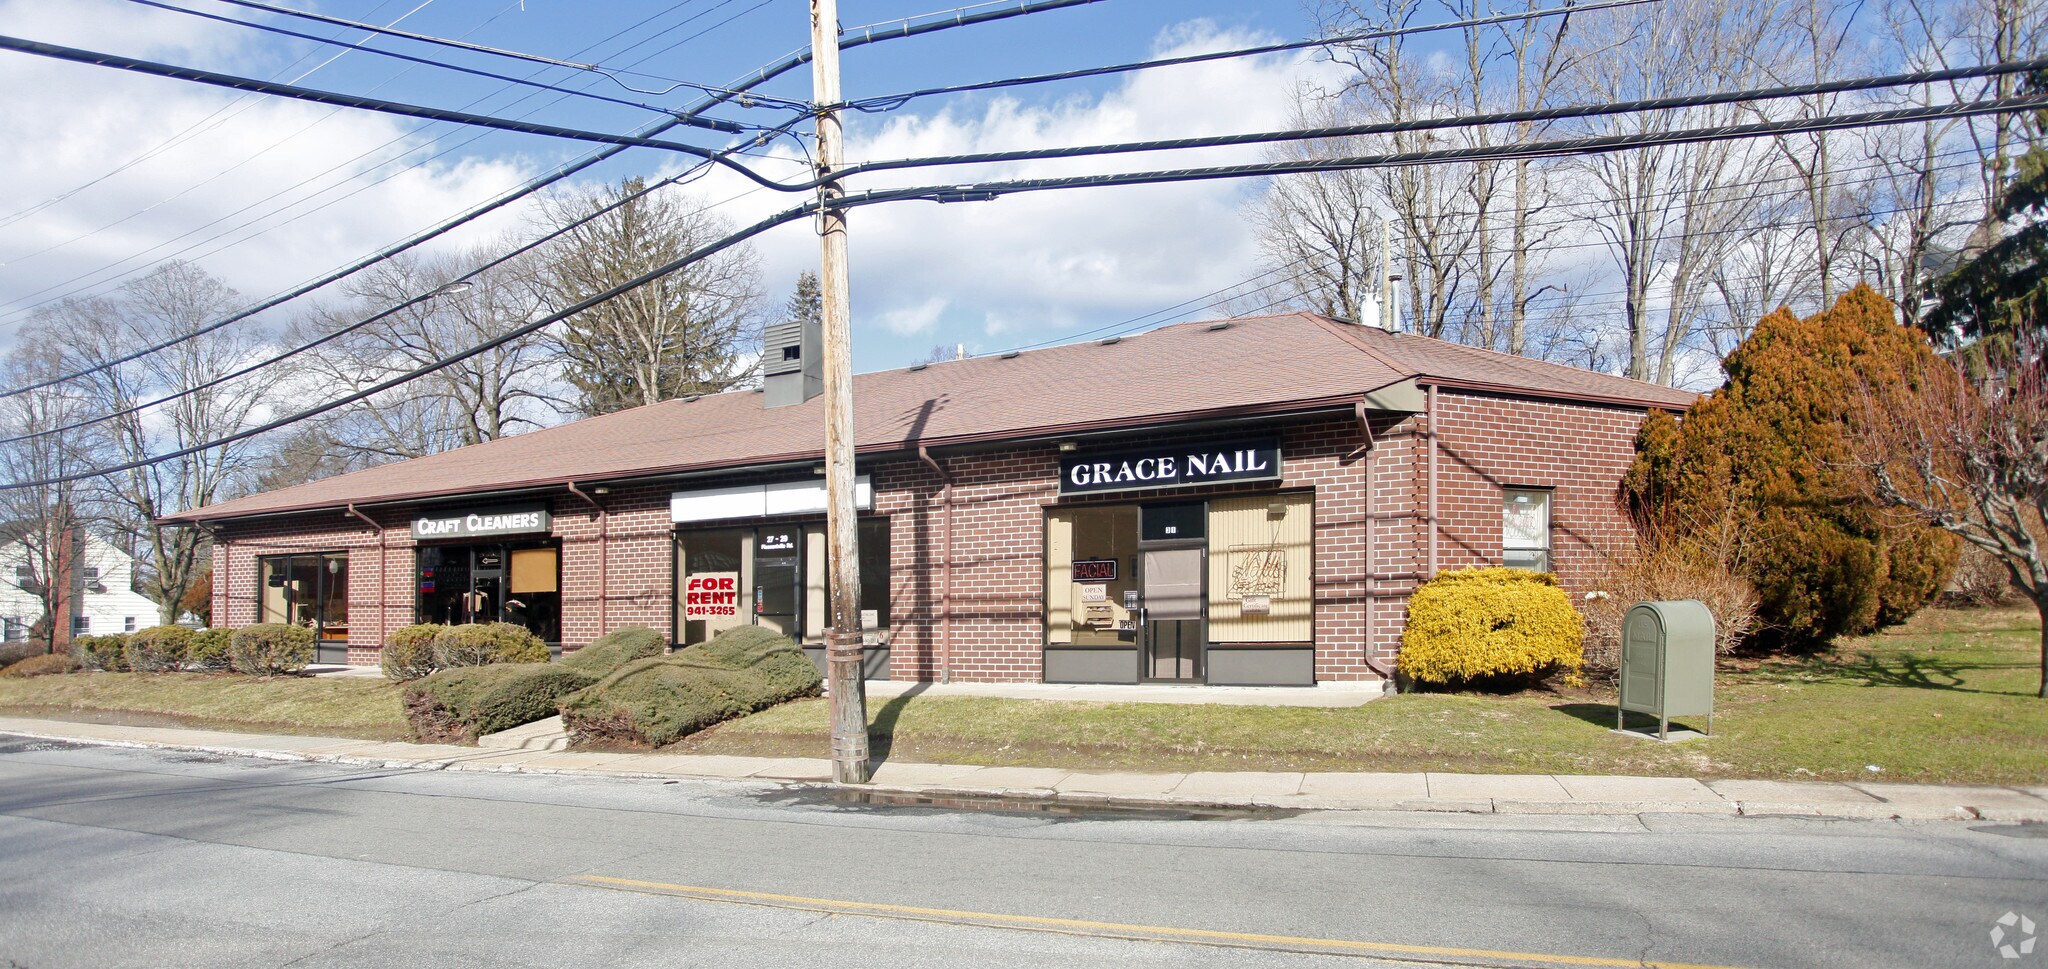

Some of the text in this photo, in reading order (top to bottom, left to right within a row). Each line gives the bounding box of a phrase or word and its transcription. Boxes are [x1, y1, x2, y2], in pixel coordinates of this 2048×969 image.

[1070, 449, 1267, 486] GRACE NAIL
[417, 513, 539, 535] CRAFT CLEANERS
[1074, 562, 1114, 579] FACIAL
[688, 577, 735, 591] FOR
[687, 591, 736, 605] RENT
[687, 605, 736, 616] 941-3265
[1120, 620, 1136, 629] OPEN
